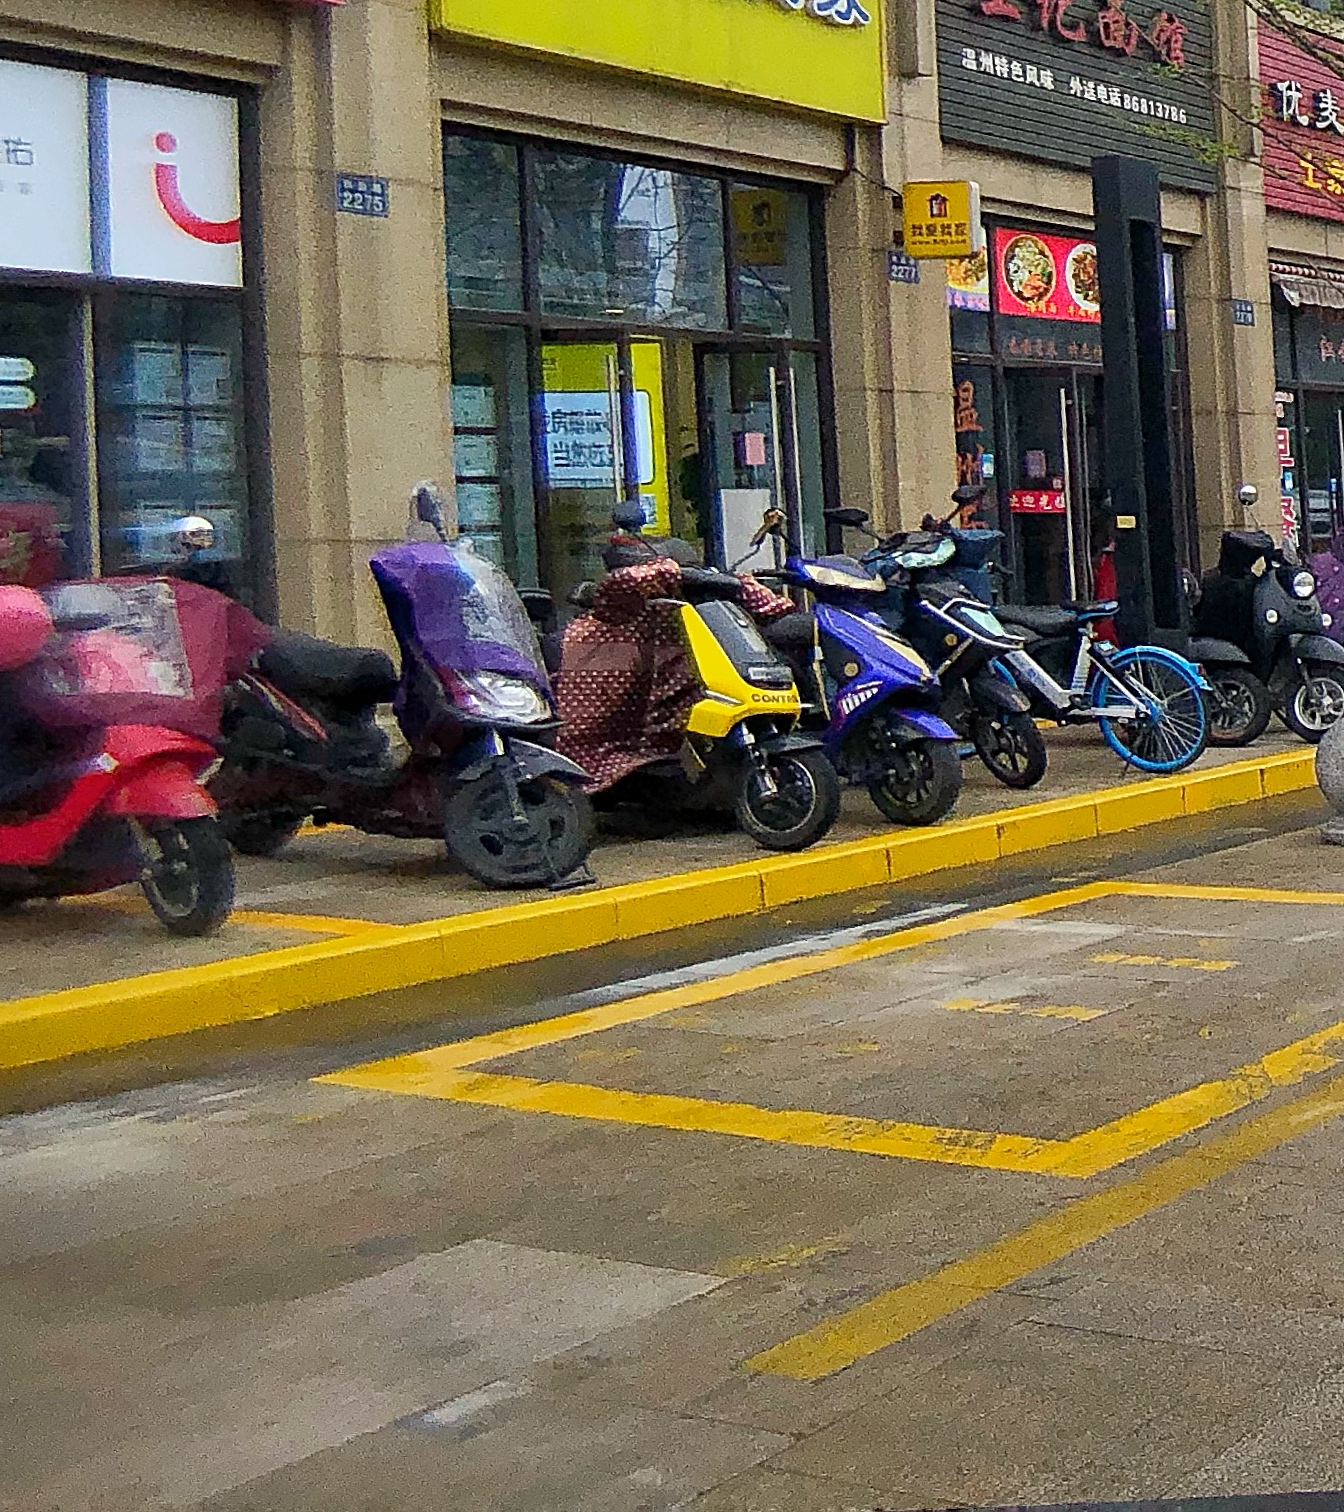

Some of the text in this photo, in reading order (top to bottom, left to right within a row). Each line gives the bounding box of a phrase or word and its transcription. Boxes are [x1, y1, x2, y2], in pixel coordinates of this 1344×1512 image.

[961, 46, 1055, 91] 温州特色风味
[343, 191, 383, 212] 2275
